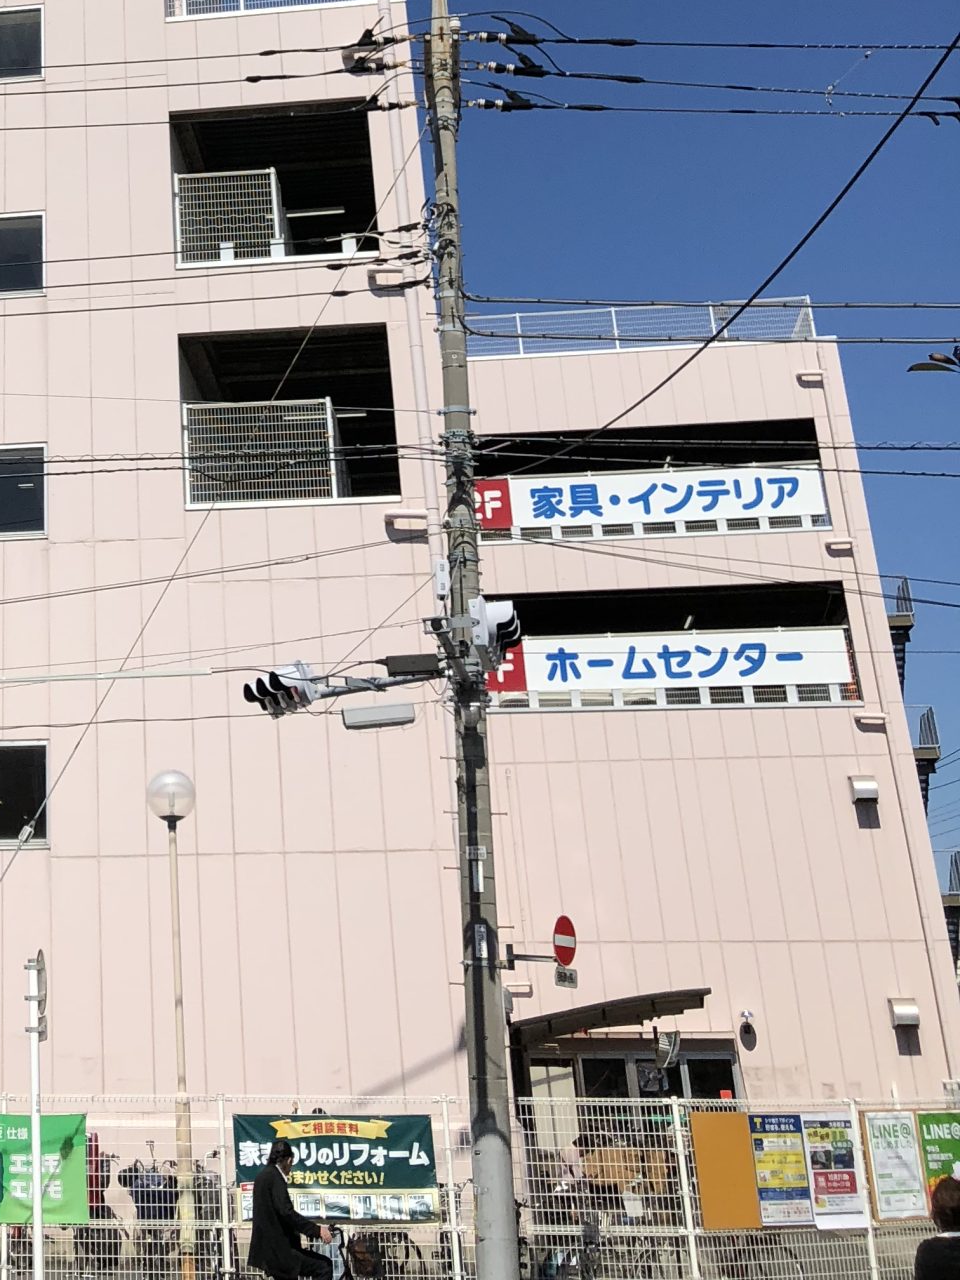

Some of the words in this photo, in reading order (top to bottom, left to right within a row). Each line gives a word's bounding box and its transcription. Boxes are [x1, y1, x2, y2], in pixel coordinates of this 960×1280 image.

[530, 477, 799, 519] 家具・インテリア
[545, 643, 803, 683] ホームセンター
[6, 1126, 28, 1140] 仕様
[301, 1122, 359, 1135] ご相談無料
[871, 1123, 911, 1139] LINE@
[923, 1123, 960, 1140] LINE@
